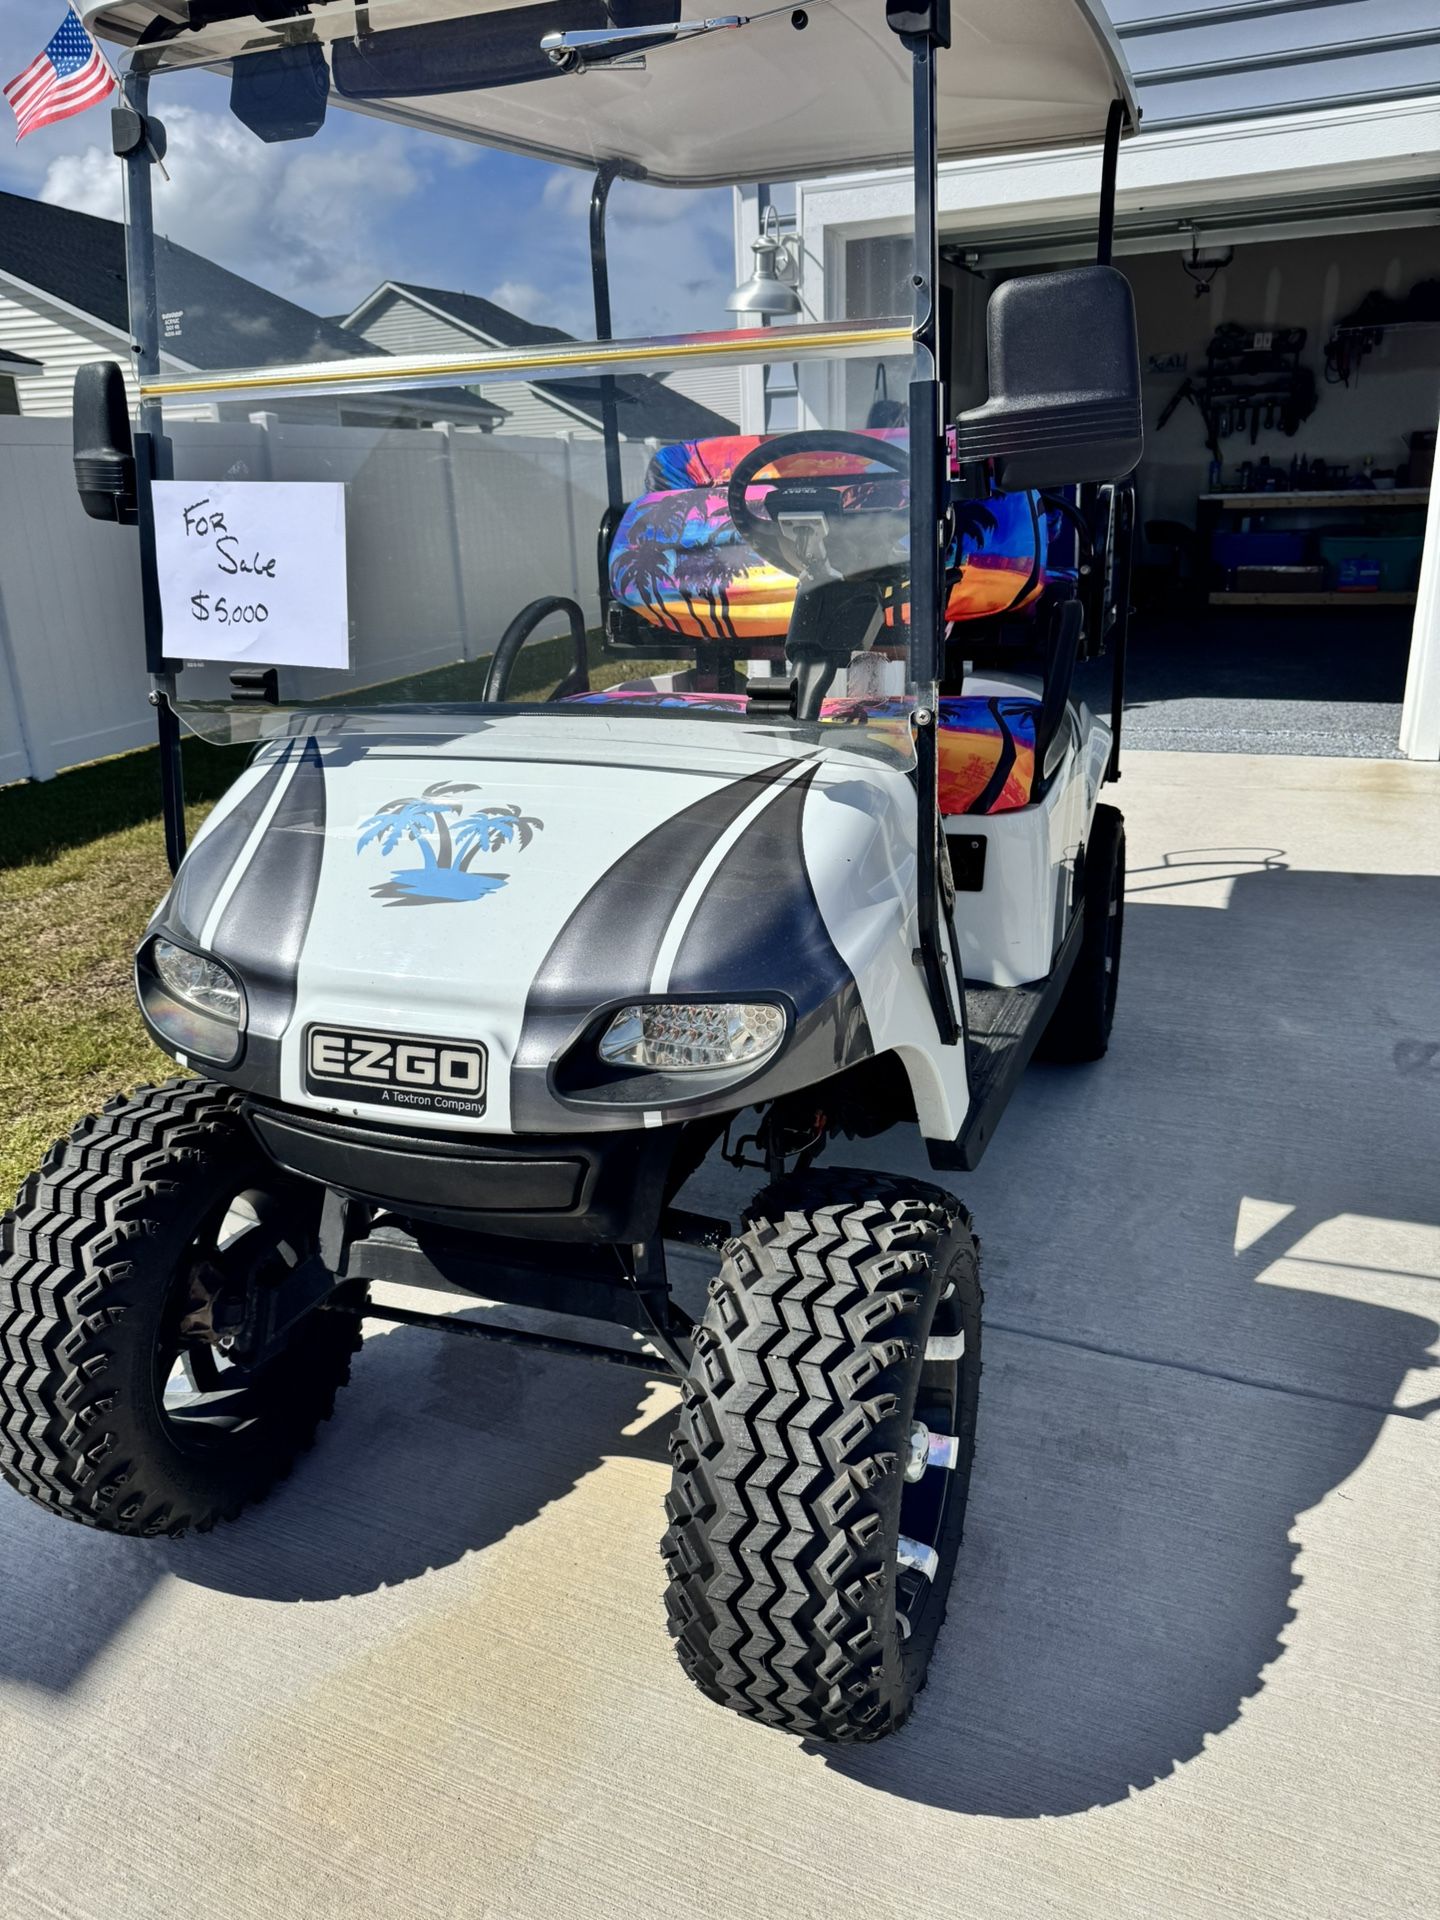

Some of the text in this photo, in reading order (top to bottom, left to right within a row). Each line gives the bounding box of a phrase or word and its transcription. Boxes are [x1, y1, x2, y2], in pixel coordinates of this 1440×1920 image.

[216, 535, 276, 578] Sale
[191, 590, 268, 626] $5,000
[381, 1090, 485, 1114] A Textron Company
